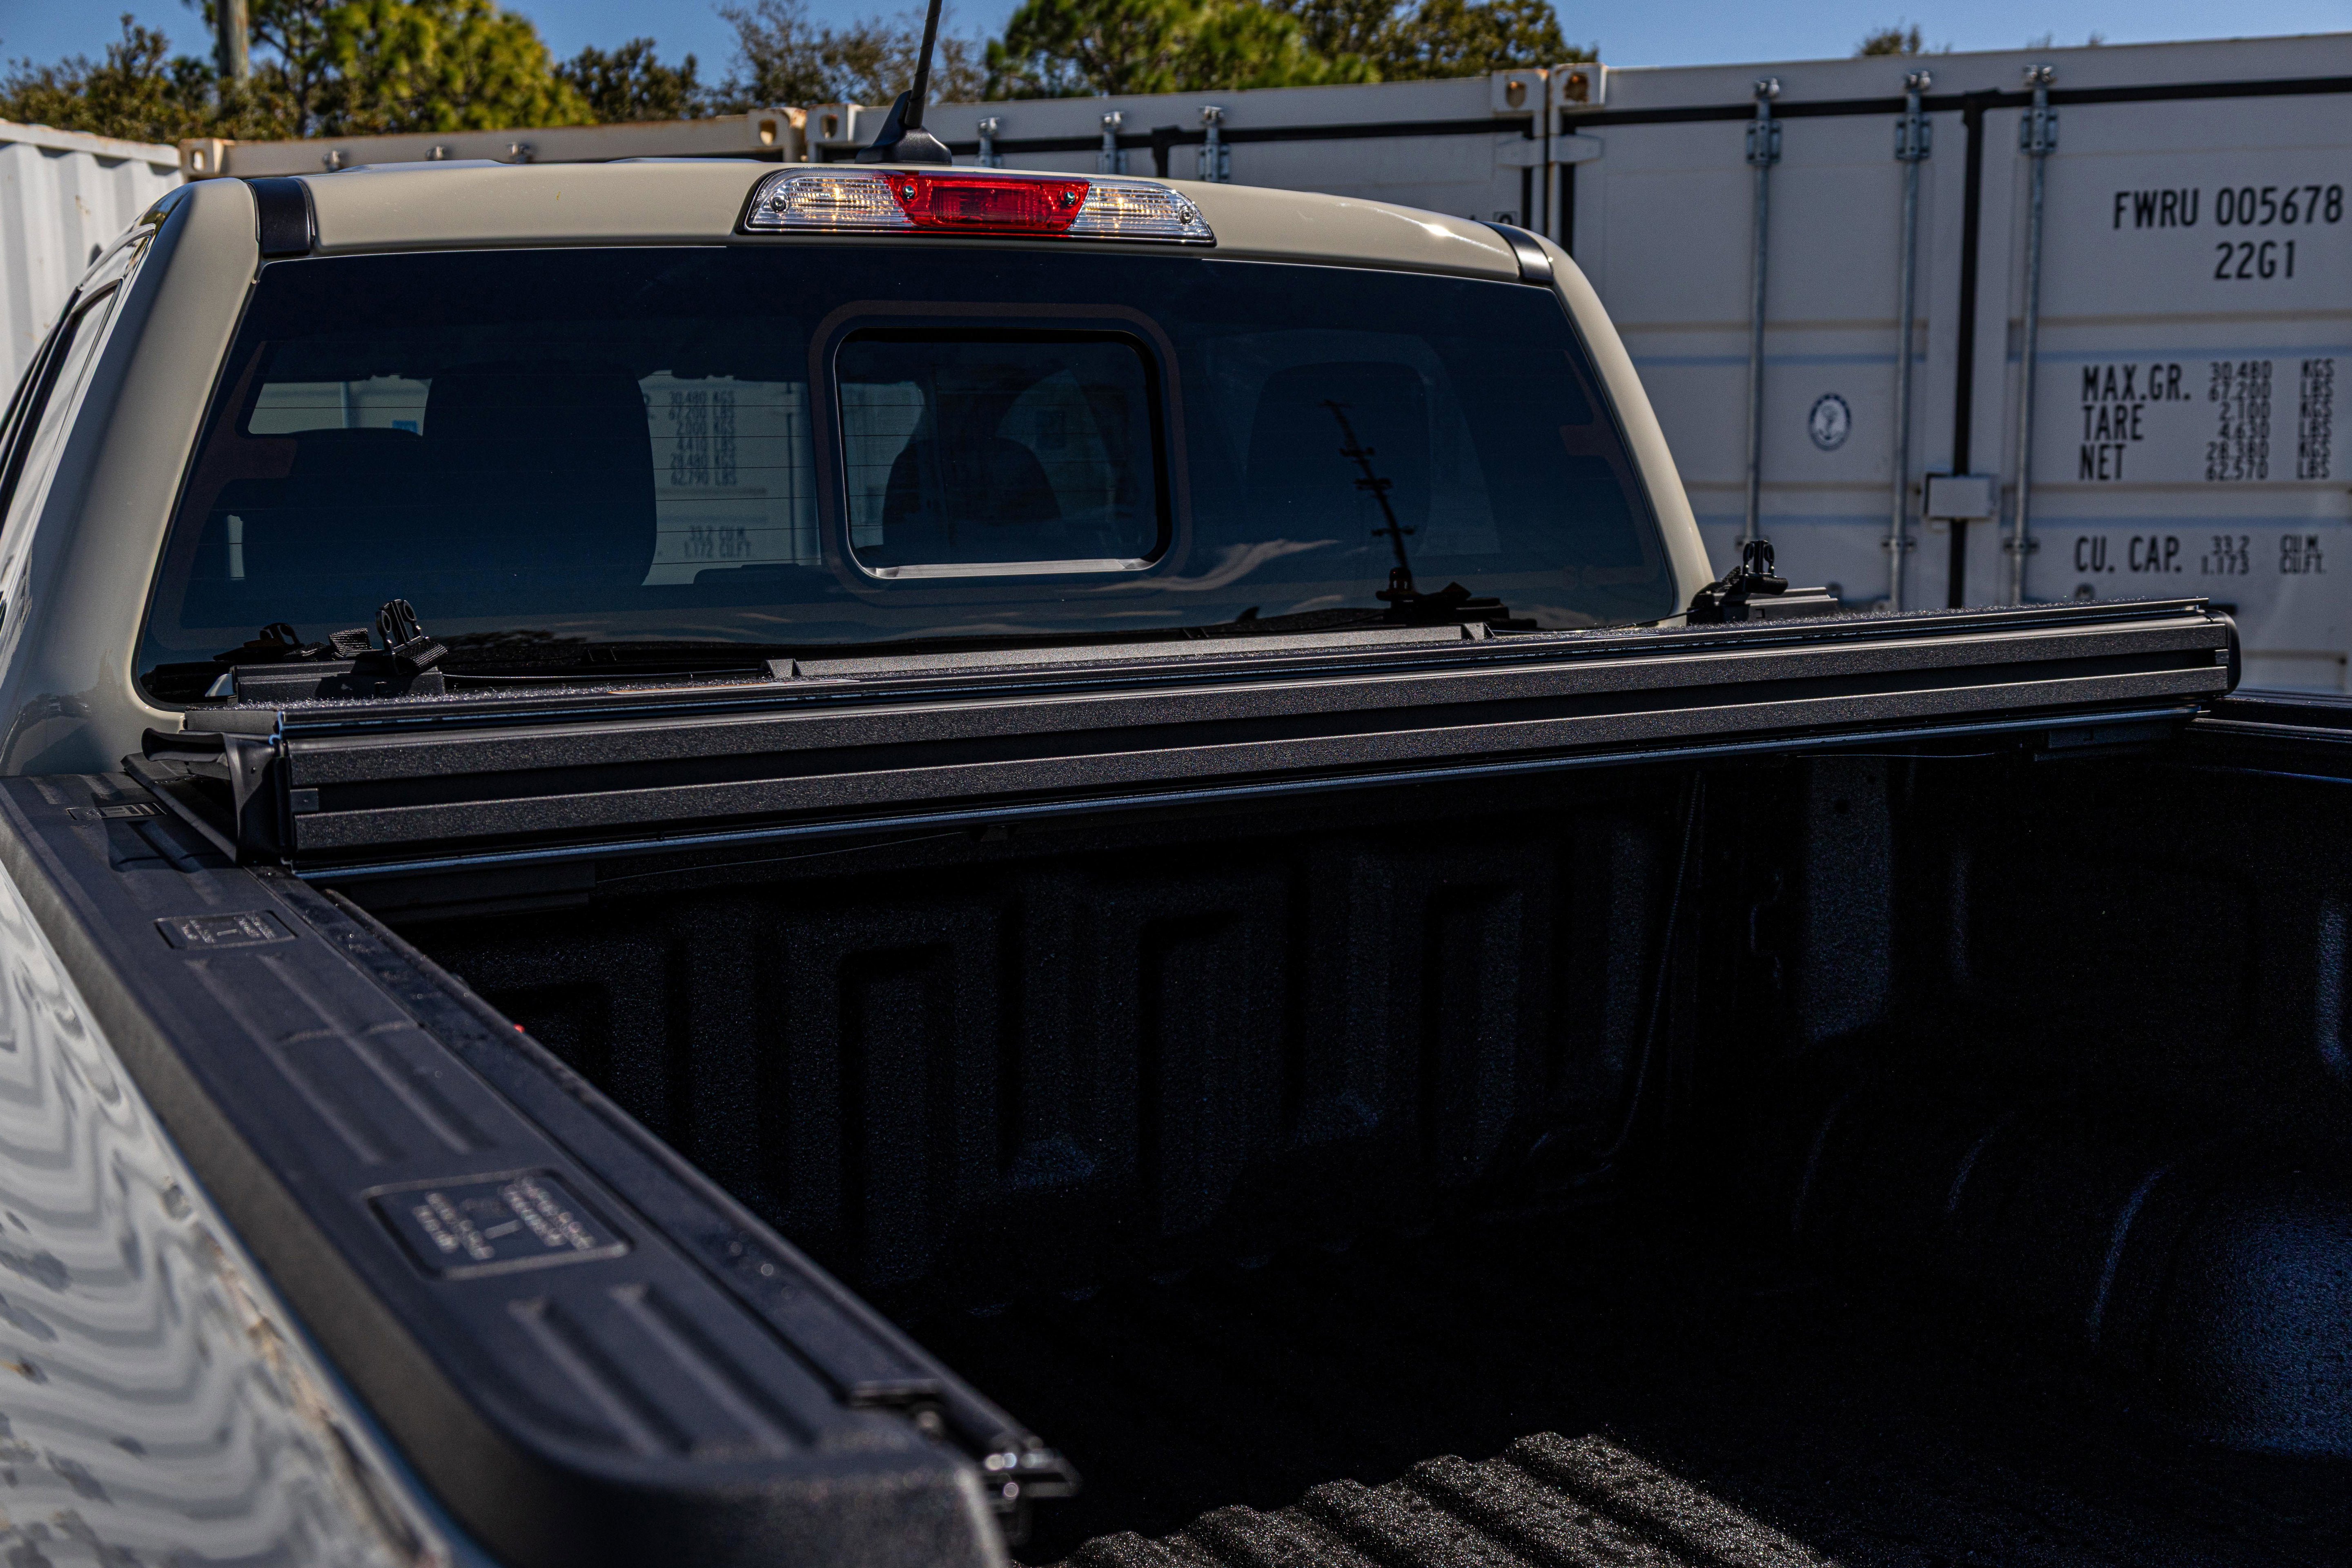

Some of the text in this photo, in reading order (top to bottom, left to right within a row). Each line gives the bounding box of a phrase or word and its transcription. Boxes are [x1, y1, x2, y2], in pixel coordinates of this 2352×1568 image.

[2114, 185, 2343, 229] FWRU 005678
[2214, 240, 2295, 280] 22G1
[2082, 363, 2191, 402] MAX.GR.
[2301, 358, 2334, 379] KGS
[2082, 403, 2145, 441] TARE
[2079, 443, 2127, 481] NET
[2075, 536, 2115, 573] CU.
[2128, 535, 2183, 573] CAP.
